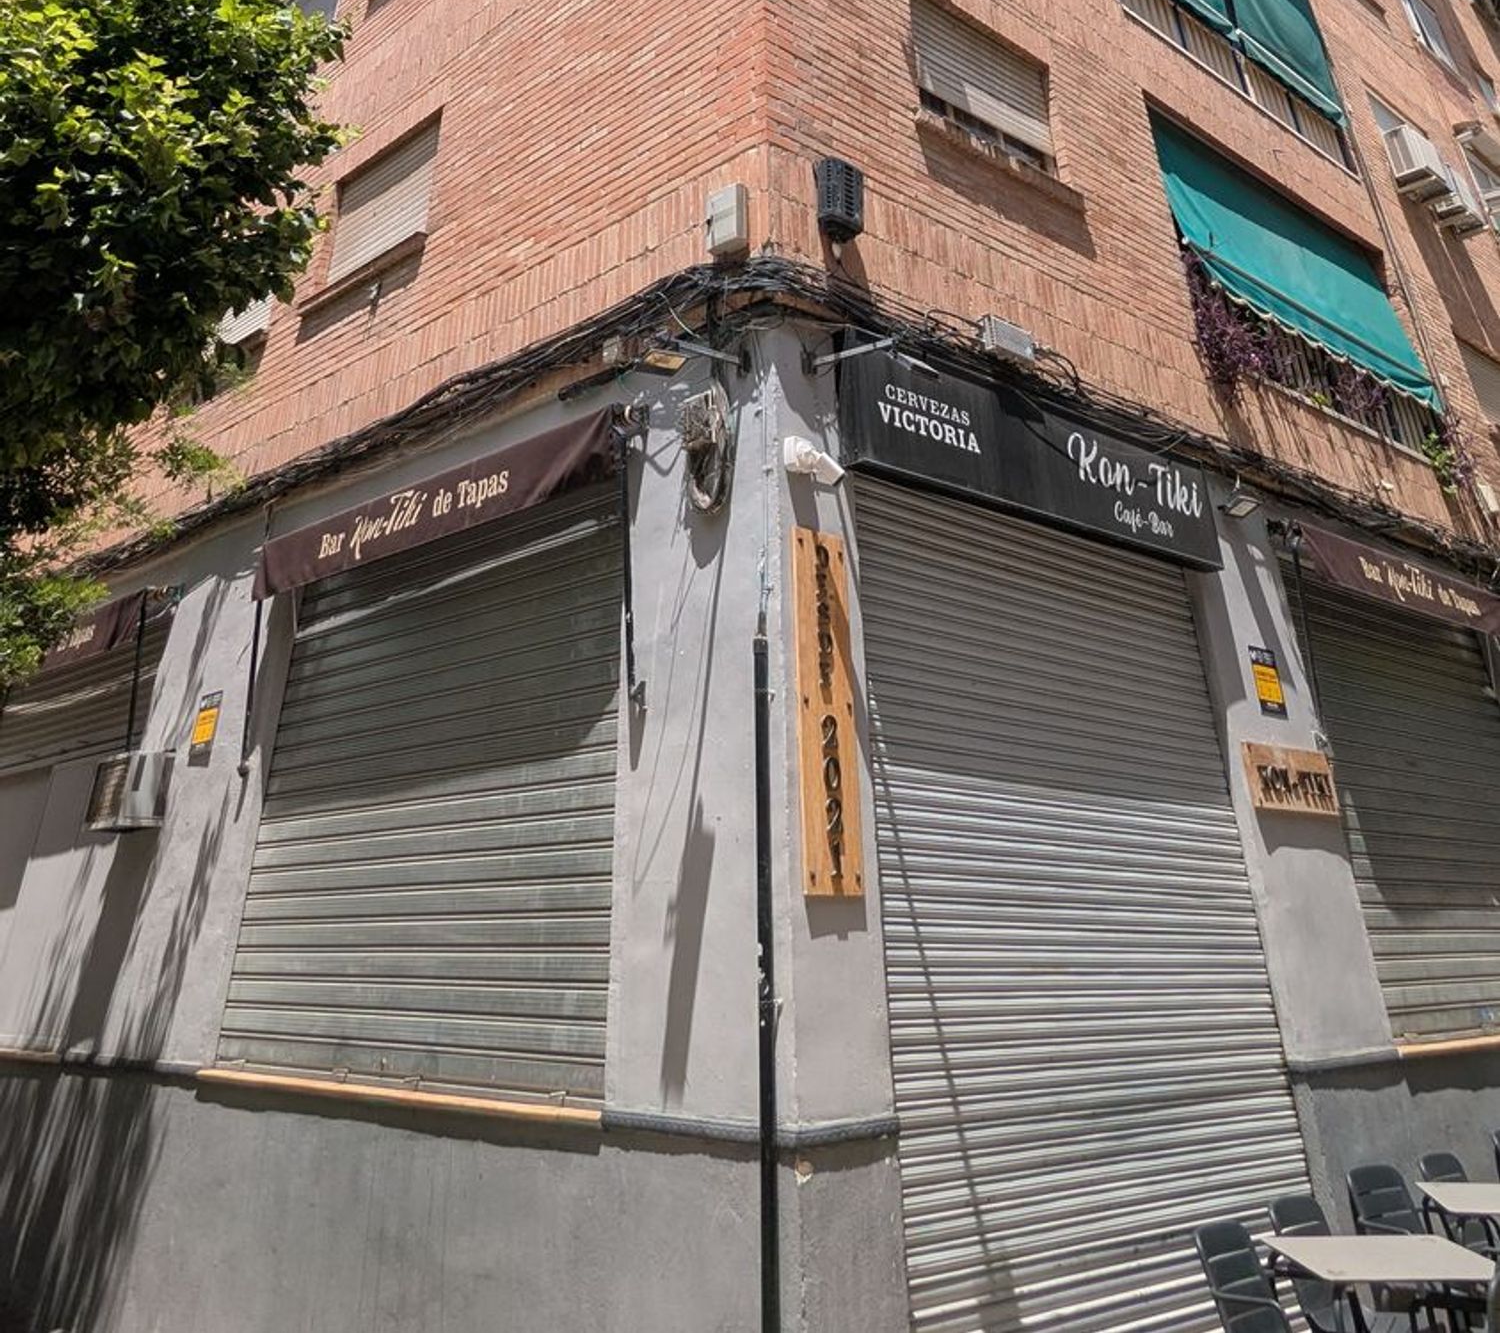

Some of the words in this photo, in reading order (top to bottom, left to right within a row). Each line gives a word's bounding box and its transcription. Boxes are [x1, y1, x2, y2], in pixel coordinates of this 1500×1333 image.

[877, 401, 982, 455] VICTORIA
[885, 384, 970, 427] CERVEZAS
[318, 533, 346, 560] Bar
[350, 489, 428, 561] Kon-Tiki
[432, 488, 453, 518] de
[457, 470, 510, 509] Tapas
[1067, 432, 1203, 518] Kon-Tiki
[821, 714, 844, 879] 2021
